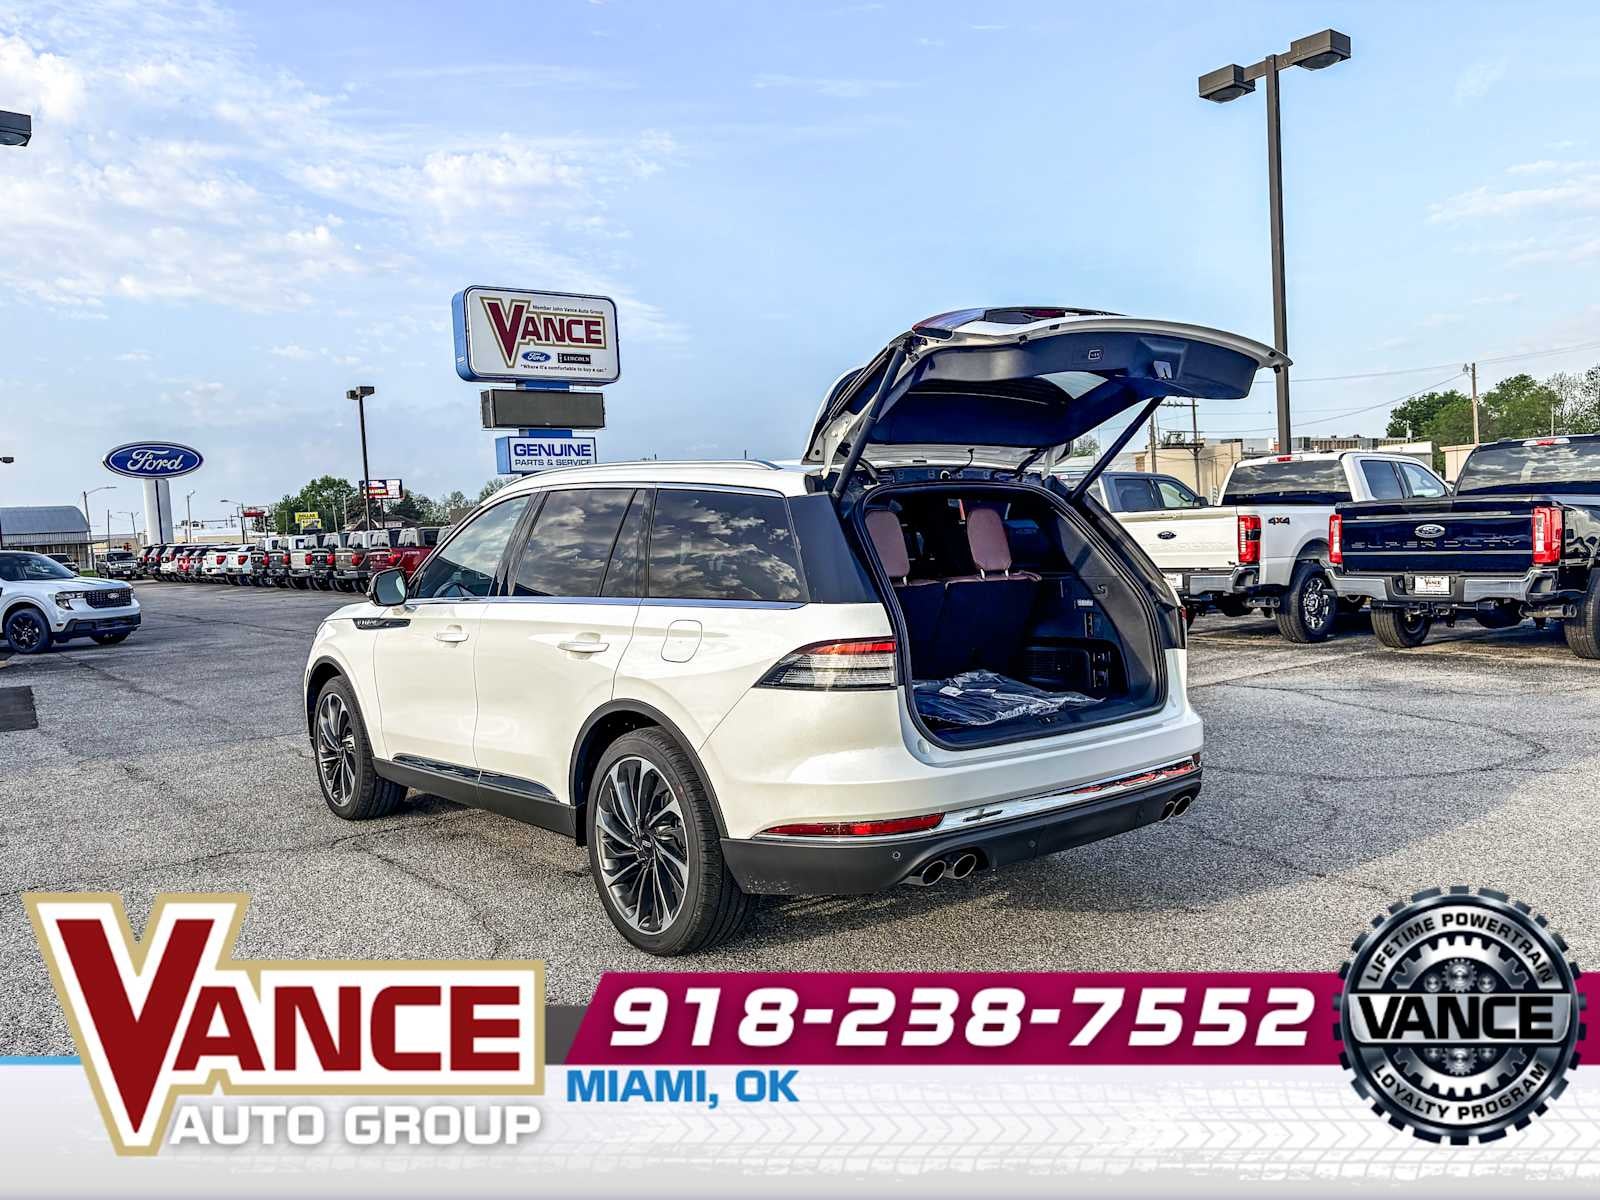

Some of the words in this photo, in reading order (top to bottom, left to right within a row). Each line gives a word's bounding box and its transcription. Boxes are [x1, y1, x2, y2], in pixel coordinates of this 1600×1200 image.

[487, 302, 603, 365] VANCE
[527, 352, 547, 361] Ford
[513, 443, 592, 457] GENUINE
[127, 449, 184, 471] Ford
